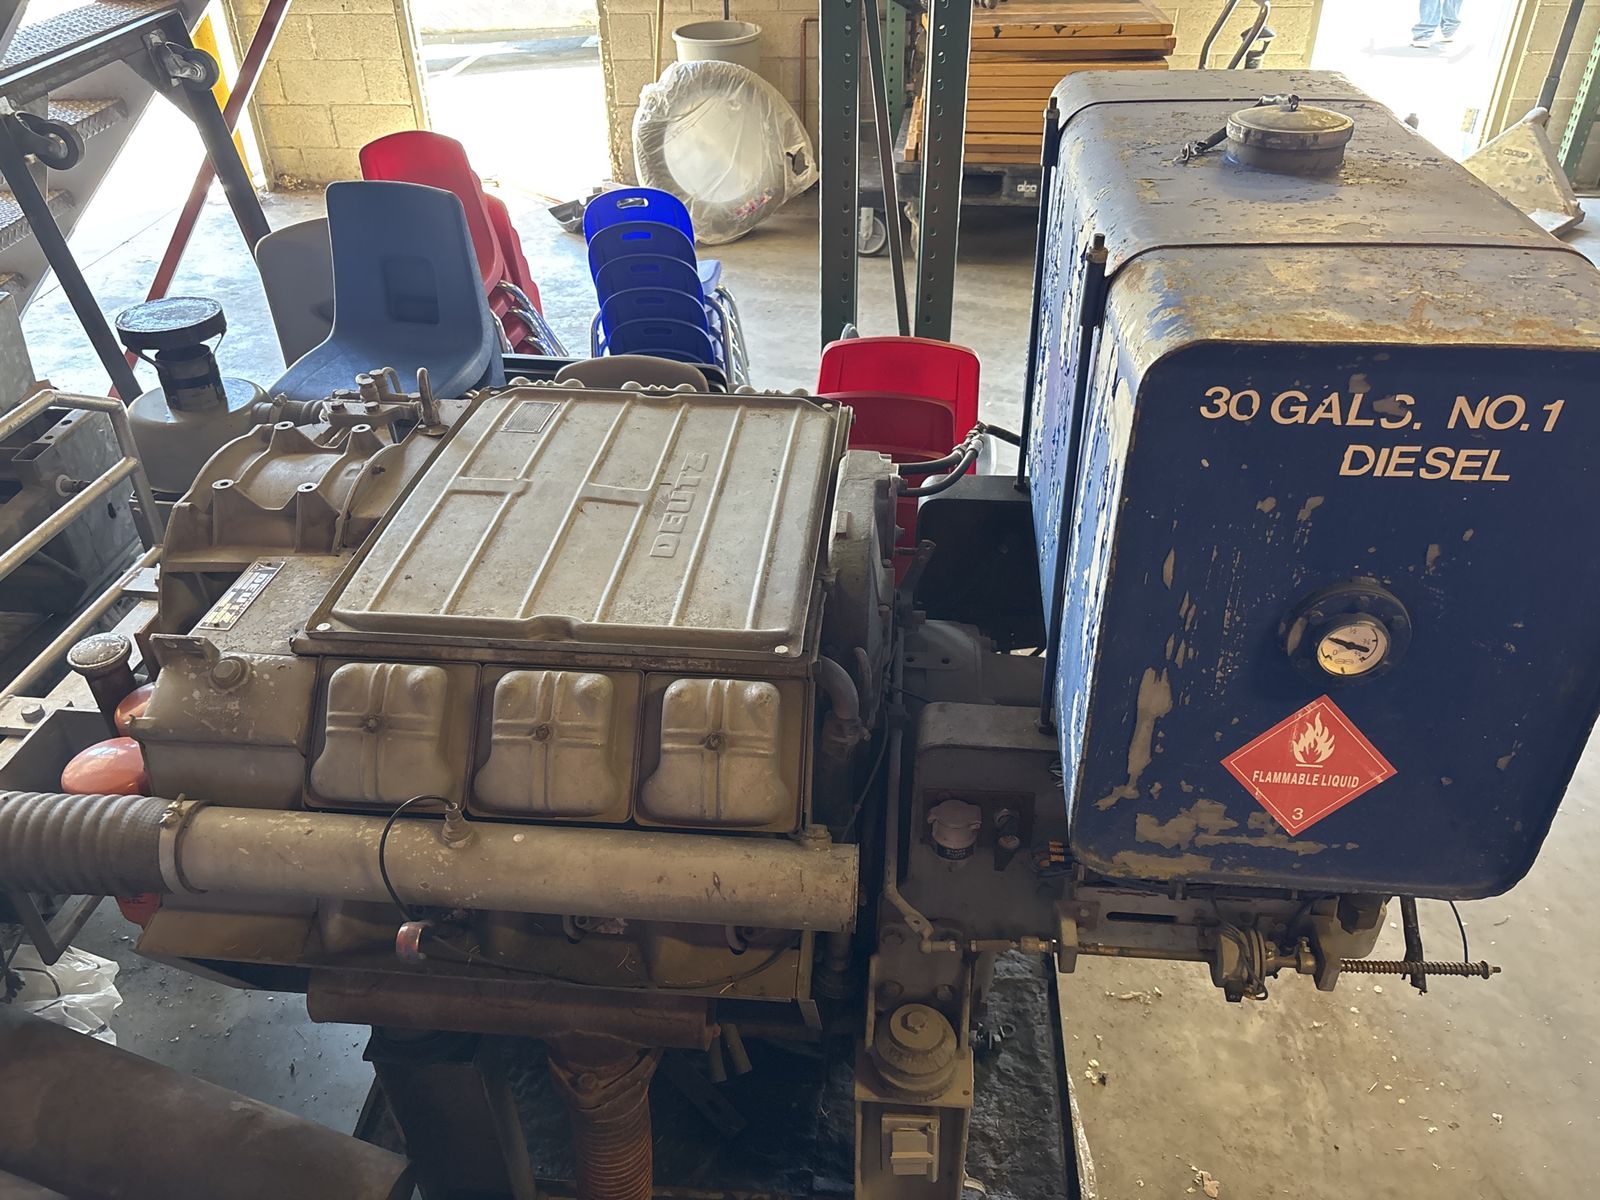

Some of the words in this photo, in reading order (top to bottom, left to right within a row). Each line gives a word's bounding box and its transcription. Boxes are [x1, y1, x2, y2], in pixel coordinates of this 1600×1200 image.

[1200, 386, 1260, 421] 30
[1270, 390, 1422, 430] GALS.
[1339, 444, 1511, 482] DIESEL
[650, 452, 709, 558] DEUTZ
[1252, 770, 1319, 786] FLAMMABLE
[1321, 774, 1360, 789] LIQUID
[1292, 807, 1304, 821] 3
